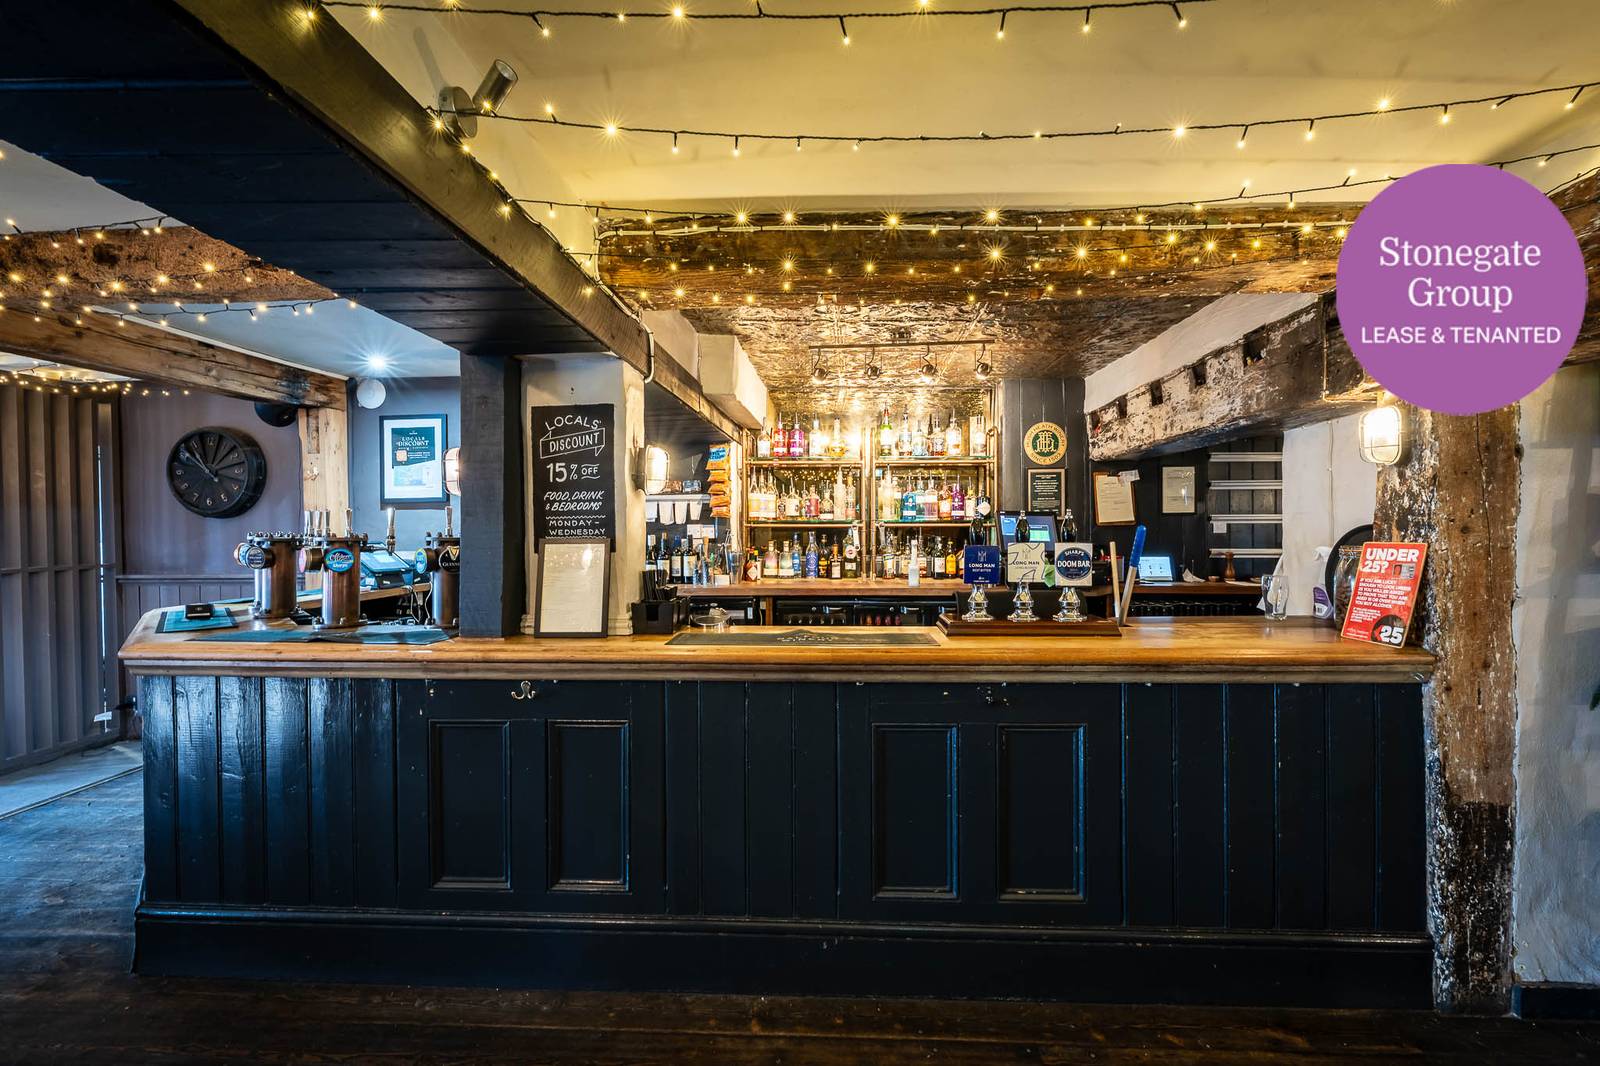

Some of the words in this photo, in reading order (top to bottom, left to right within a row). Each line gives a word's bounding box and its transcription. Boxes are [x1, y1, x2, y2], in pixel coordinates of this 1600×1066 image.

[545, 414, 602, 430] LOCALS'
[549, 432, 600, 453] DISCOUNT
[581, 467, 599, 476] OFF
[206, 497, 212, 506] 6
[544, 491, 570, 502] FOOD,
[571, 490, 604, 500] DRINK
[551, 502, 602, 512] BEDROOMS
[549, 528, 606, 536] WEDNESDAY
[1366, 548, 1420, 562] UNDER
[1361, 560, 1389, 574] 25?
[1380, 626, 1404, 644] 25
